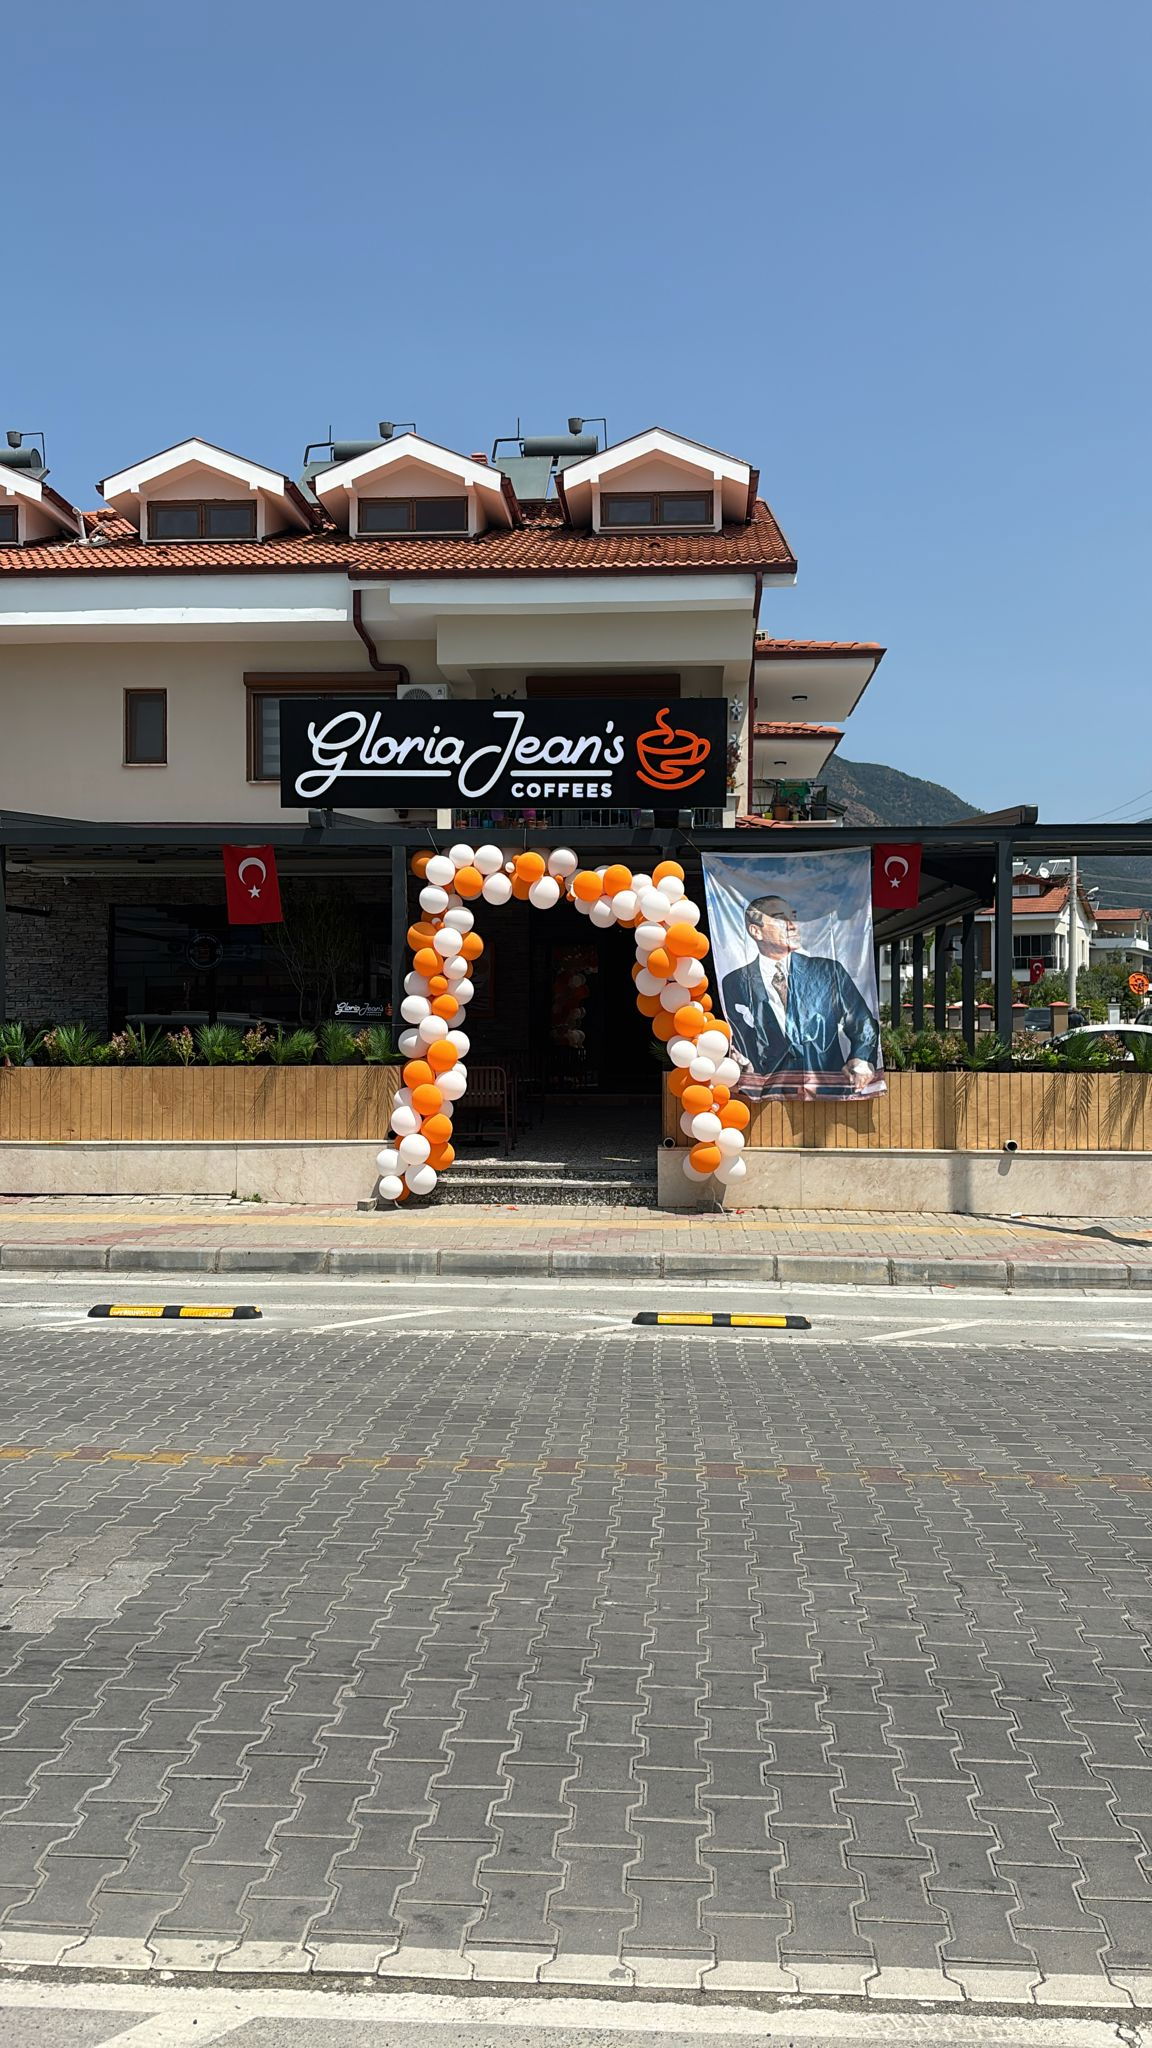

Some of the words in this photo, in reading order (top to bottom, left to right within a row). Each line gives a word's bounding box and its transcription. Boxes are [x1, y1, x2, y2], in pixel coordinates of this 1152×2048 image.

[295, 711, 464, 798] Gloria
[458, 710, 625, 798] Jean's
[511, 782, 613, 798] COFFEES
